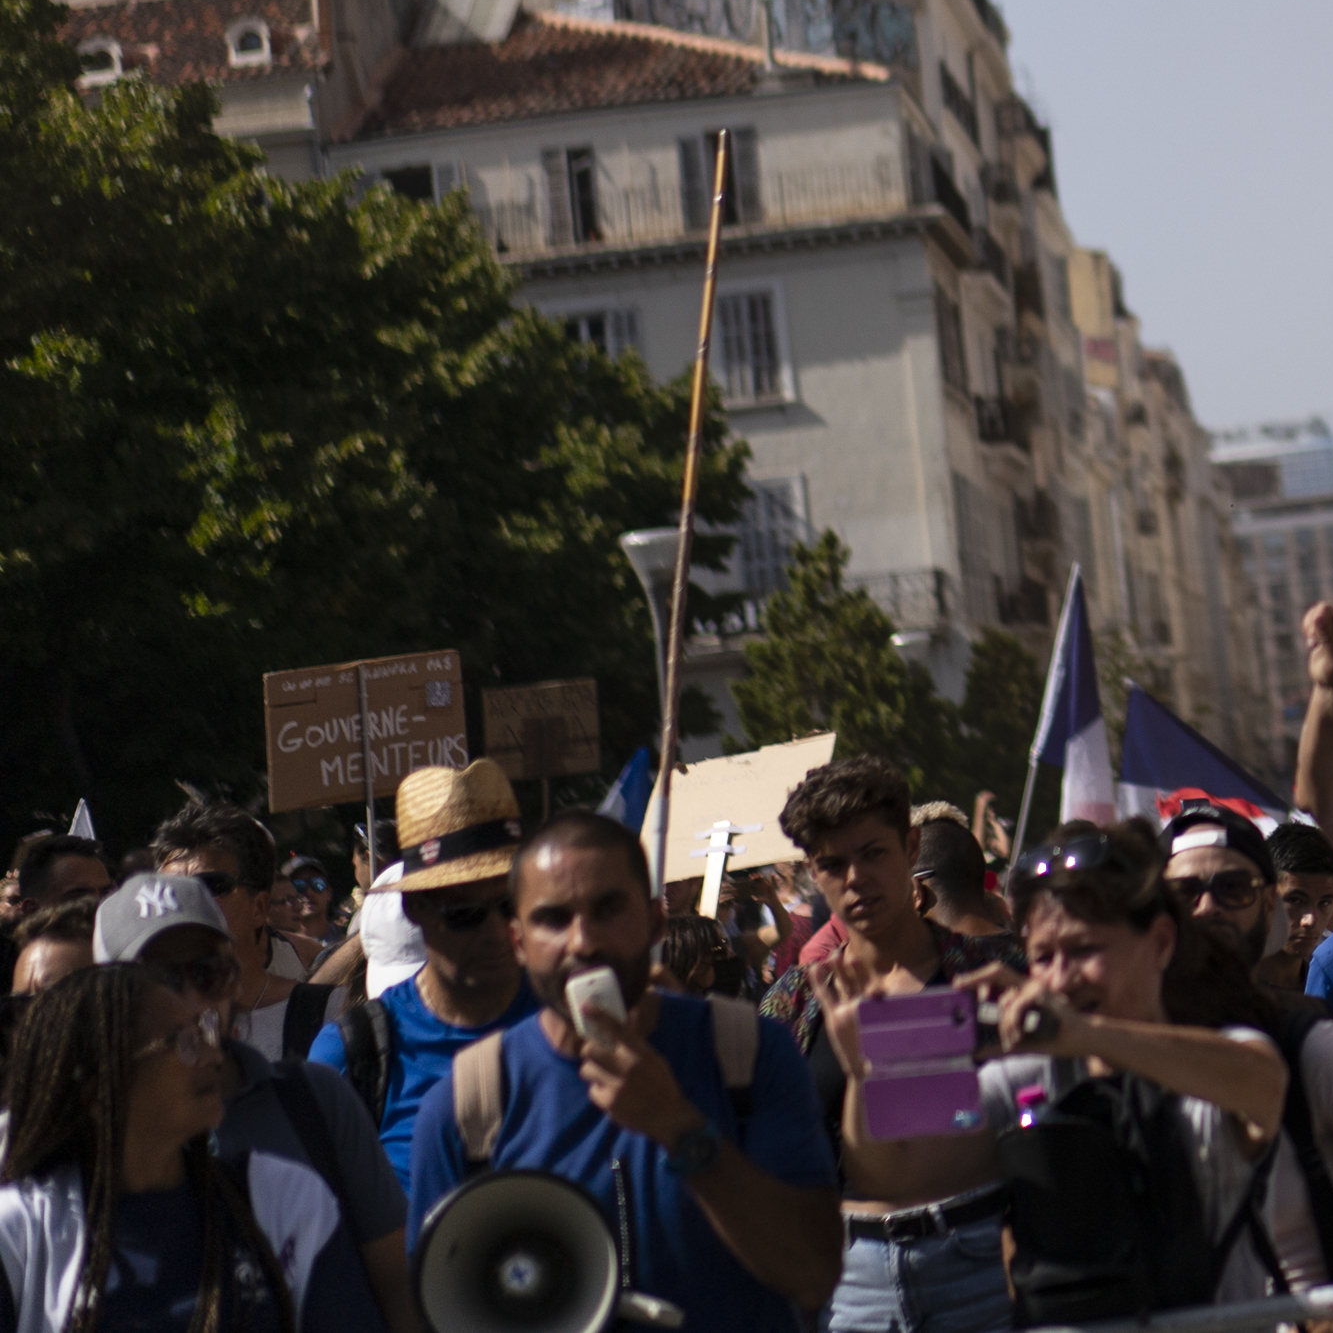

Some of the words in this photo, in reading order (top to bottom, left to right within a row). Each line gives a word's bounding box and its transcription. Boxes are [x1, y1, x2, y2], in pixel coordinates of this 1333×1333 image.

[277, 704, 427, 753] GOUVERNE-
[320, 733, 469, 787] MENTEURS
[135, 881, 179, 919] NY
